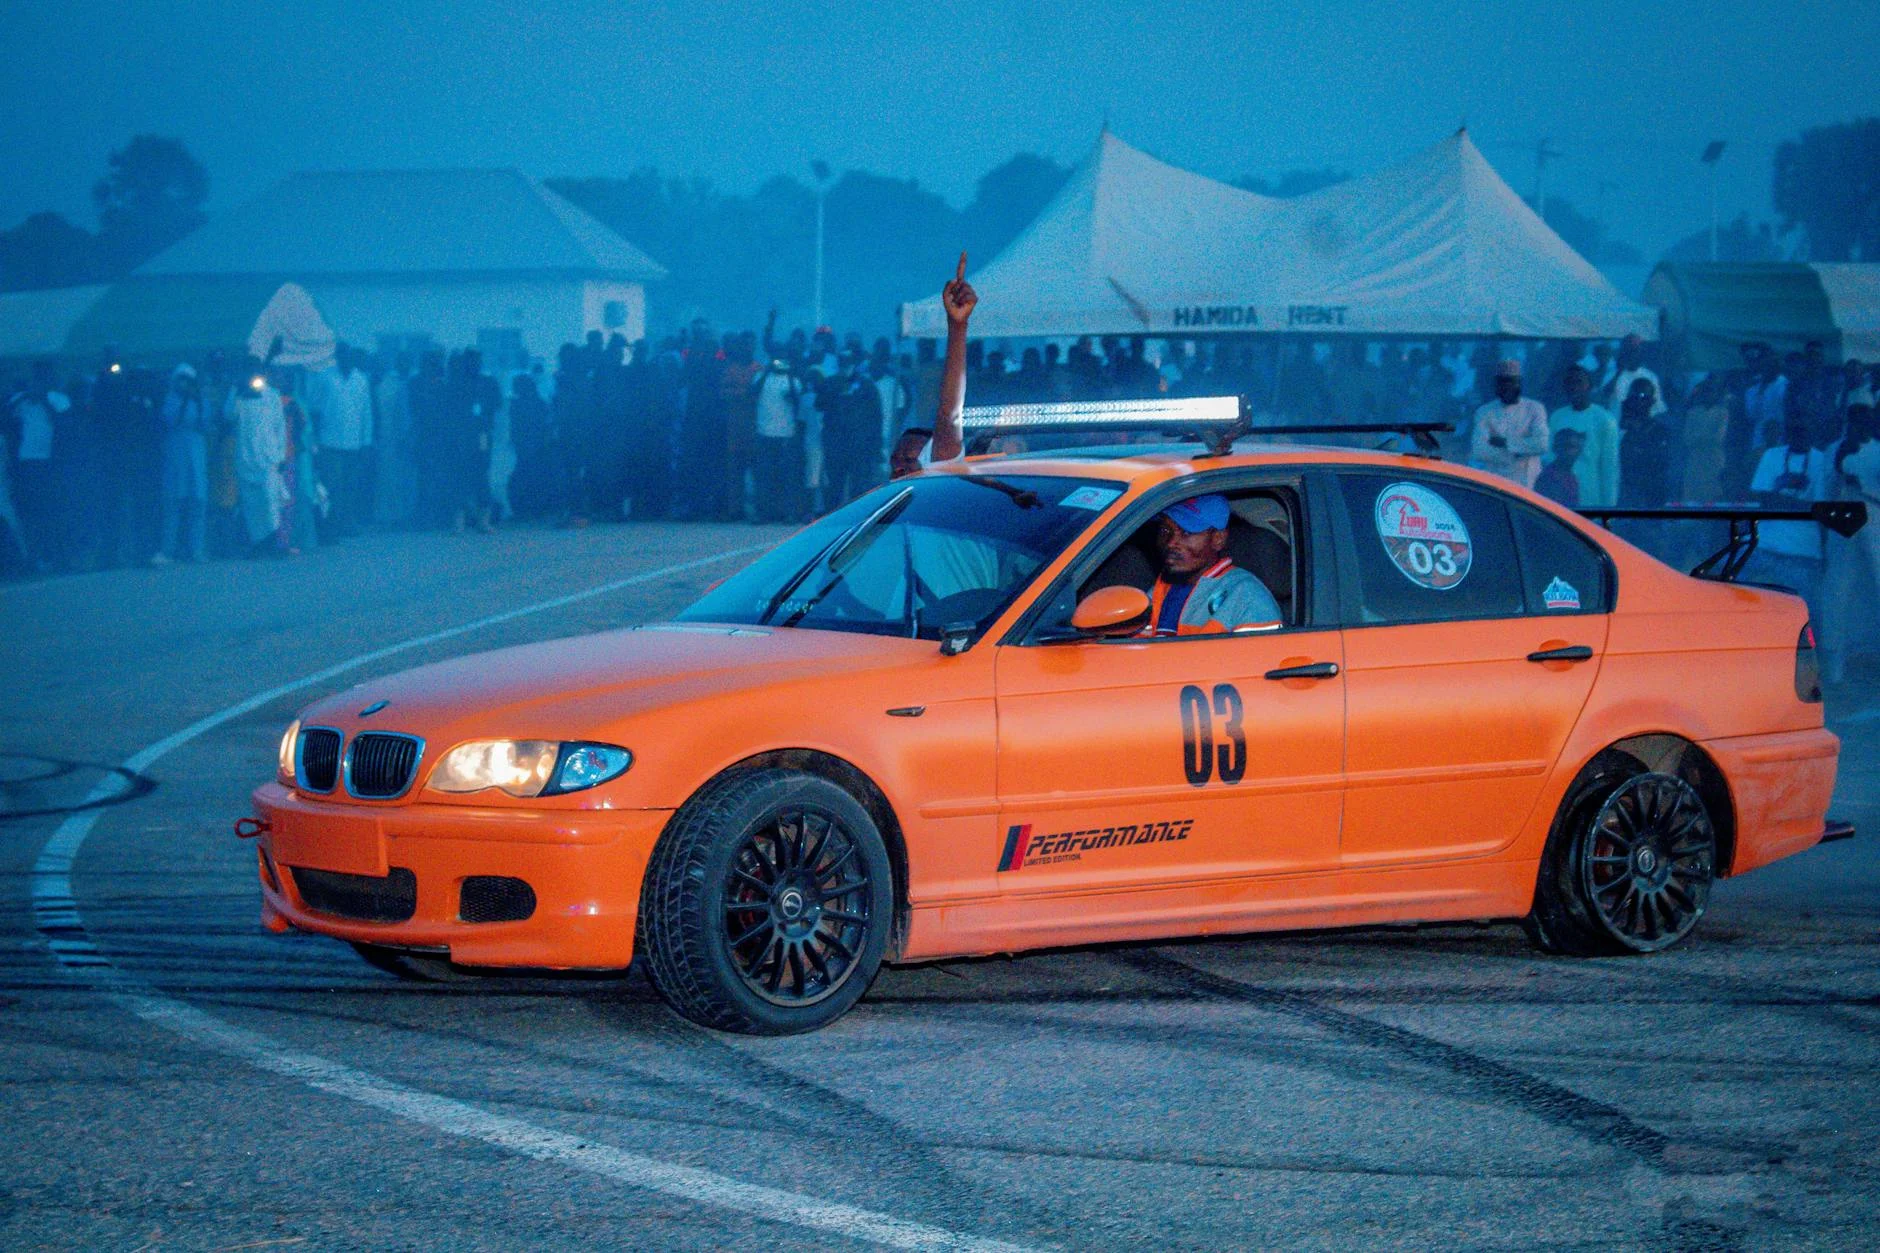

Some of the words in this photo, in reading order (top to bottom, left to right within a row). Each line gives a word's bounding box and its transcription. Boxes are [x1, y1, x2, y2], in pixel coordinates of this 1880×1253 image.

[1173, 306, 1259, 326] HAMIDA
[1408, 541, 1457, 576] 03
[1180, 683, 1247, 787] 03
[1026, 819, 1194, 856] PERFORMANCE
[1023, 856, 1051, 867] LIMITED
[1053, 853, 1082, 864] EDITION
